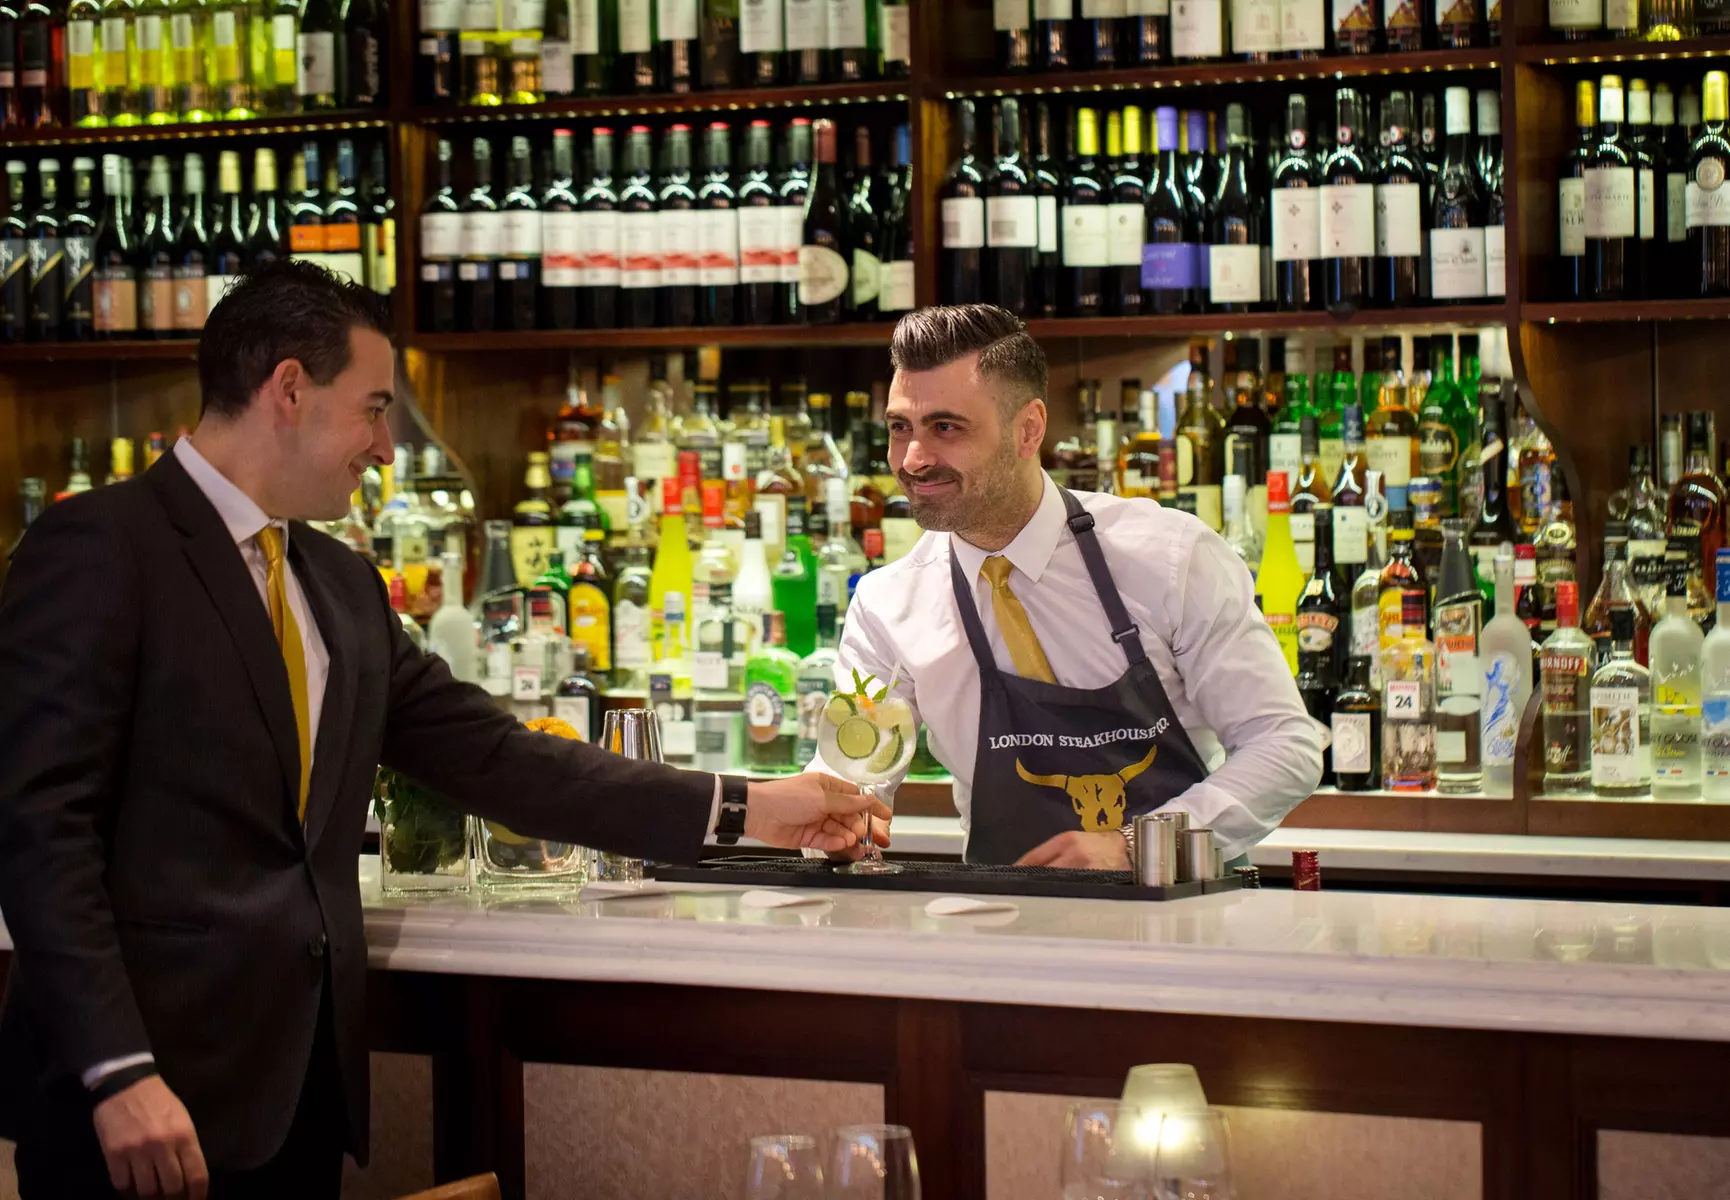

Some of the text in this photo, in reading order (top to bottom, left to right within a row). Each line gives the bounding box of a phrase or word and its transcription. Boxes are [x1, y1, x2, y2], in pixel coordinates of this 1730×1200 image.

[1540, 656, 1581, 670] IRNOFF
[1395, 694, 1413, 710] 24
[989, 733, 1054, 749] LONDON
[1059, 728, 1156, 748] STEAKHOUSE
